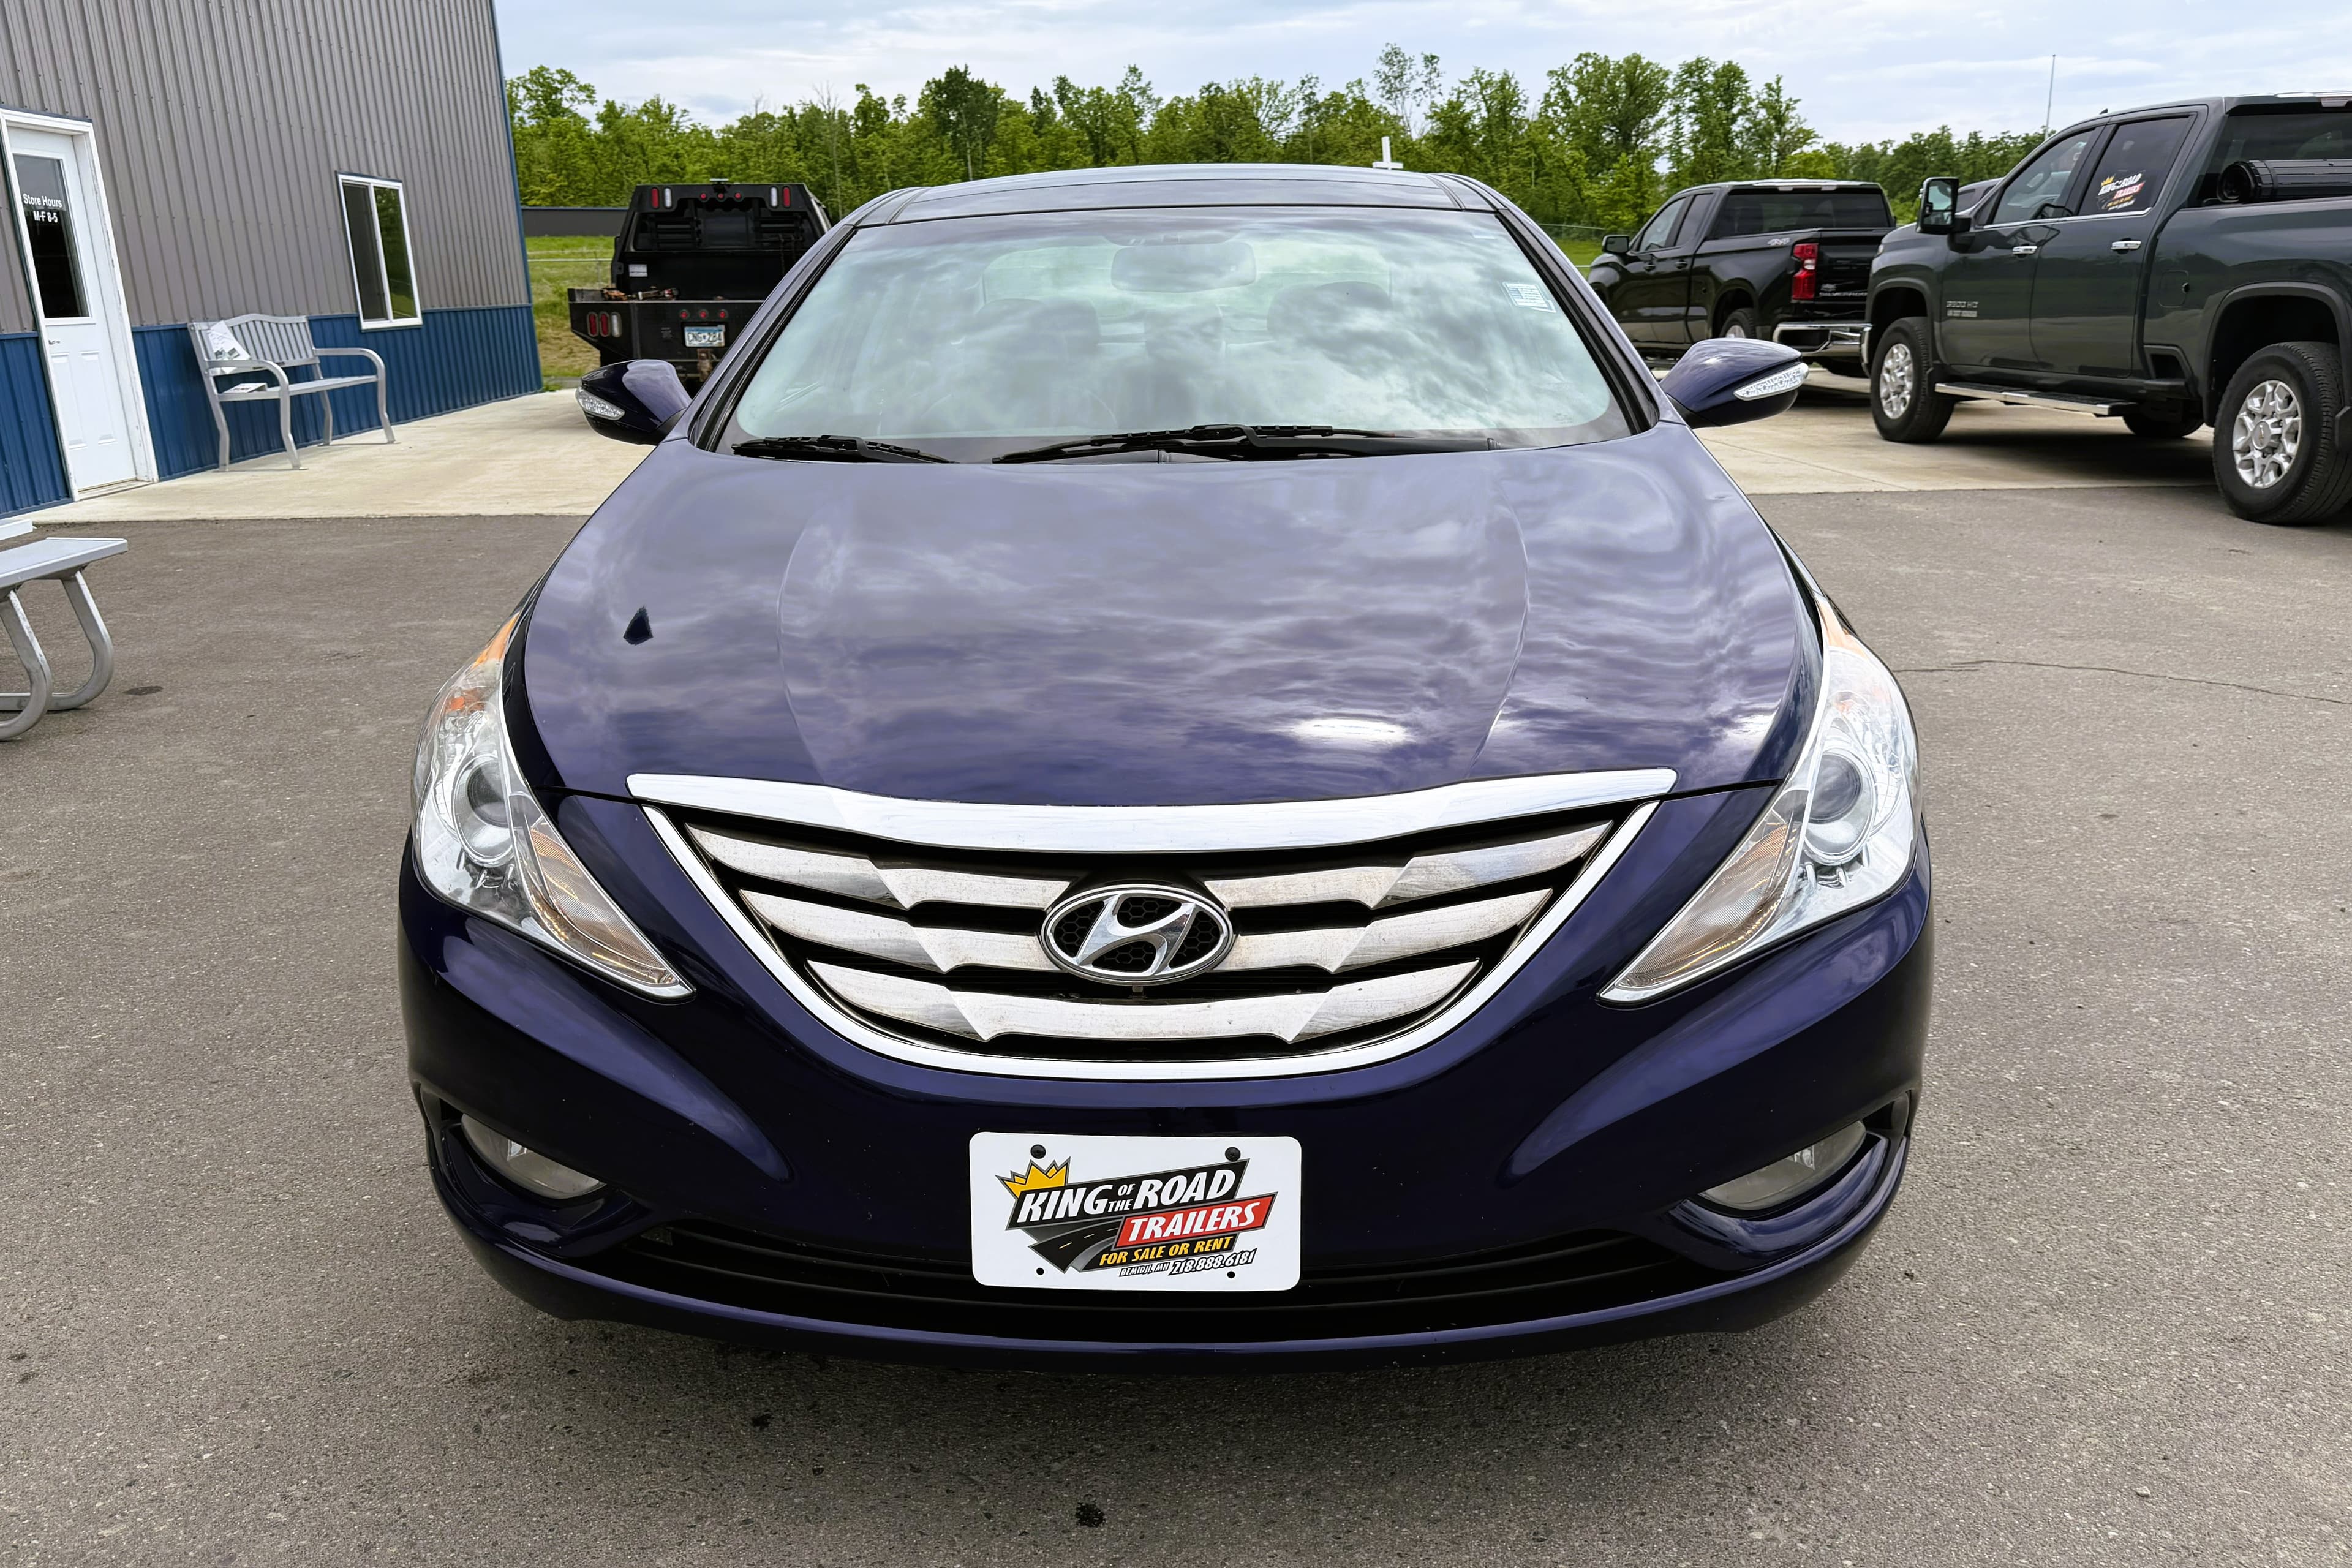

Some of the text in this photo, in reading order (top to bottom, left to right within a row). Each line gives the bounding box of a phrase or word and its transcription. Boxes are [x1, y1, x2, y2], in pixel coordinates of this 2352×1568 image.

[23, 193, 62, 208] Store Hours
[33, 210, 58, 223] M-F 8-5
[1017, 1169, 1236, 1223] KING OF THE ROAD
[1128, 1202, 1261, 1242] TRAILERS
[1099, 1236, 1234, 1266] FOR SALE OR RENT
[1120, 1250, 1256, 1277] BEMIDJI, MN 218.888.6181
